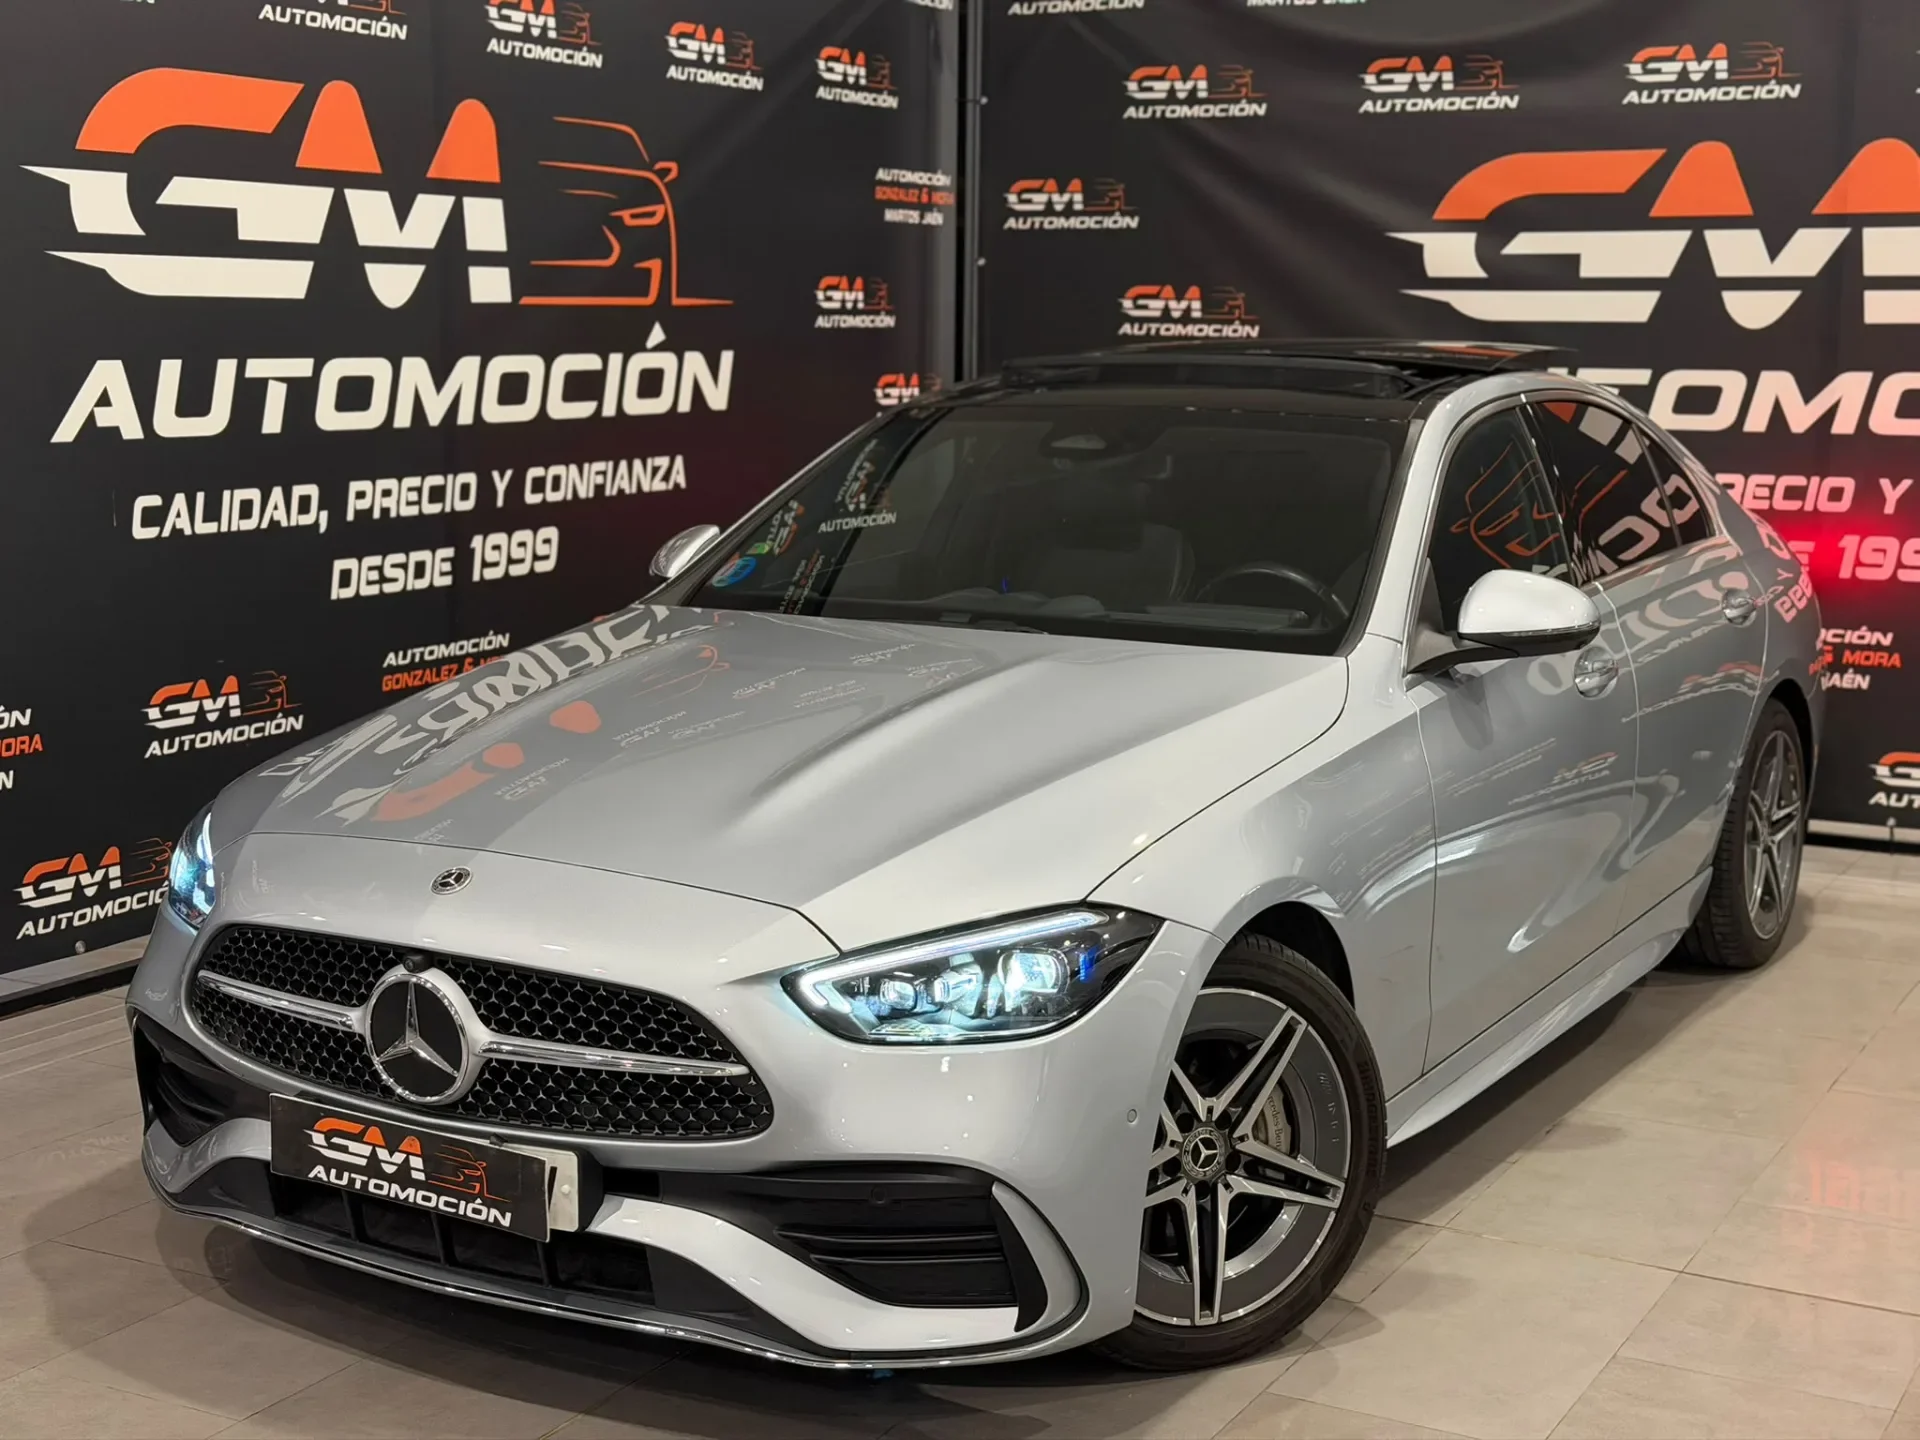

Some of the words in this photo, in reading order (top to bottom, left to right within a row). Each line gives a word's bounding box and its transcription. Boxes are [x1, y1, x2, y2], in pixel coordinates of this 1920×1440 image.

[258, 3, 407, 40] AUTOMOCIÓN
[486, 38, 603, 68] AUTOMOCIÓN
[664, 21, 726, 66] GM
[666, 65, 764, 91] AUTOMOCIÓN
[815, 46, 867, 87] GM
[1358, 55, 1455, 94] GM
[1623, 42, 1729, 83] GM
[816, 84, 899, 109] AUTOMOCIÓN
[1122, 64, 1209, 100] GM
[1622, 79, 1802, 106] AUTOMOCIÓN
[1122, 99, 1268, 120] AUTOMOCIÓN
[1358, 91, 1520, 114] AUTOMOCIÓN
[20, 67, 512, 309] GM
[1003, 177, 1084, 212] GM
[1003, 211, 1140, 230] AUTOMOCIÓN
[815, 275, 865, 310] GM
[1117, 284, 1202, 319] GM
[814, 313, 896, 329] AUTOMOCIÓN
[1117, 320, 1260, 339] AUTOMOCIÓN
[50, 321, 735, 444] AUTOMOCIÓN
[131, 484, 328, 541] CALIDAD,
[346, 472, 478, 524] PRECIO
[491, 470, 513, 508] Y
[523, 455, 687, 505] CONFIANZA
[1714, 473, 1856, 513] RECIO
[1879, 478, 1914, 515] Y
[818, 510, 897, 534] AUTOMOCIÓN
[330, 547, 456, 601] DESDE
[470, 526, 560, 582] 1999
[383, 630, 510, 668] AUTOMOCIÓN
[1842, 649, 1902, 669] MORA
[382, 663, 459, 692] GONZALEZ
[141, 675, 242, 729] GM
[0, 733, 43, 758] ORA
[144, 711, 303, 759] AUTOMOCIÓN
[12, 846, 122, 908] GM
[16, 881, 170, 940] AUTOMOCIÓ
[1268, 1094, 1285, 1149] rcedes-Ben
[303, 1117, 425, 1181] GM
[307, 1165, 512, 1228] AUTOMOCIÓN
